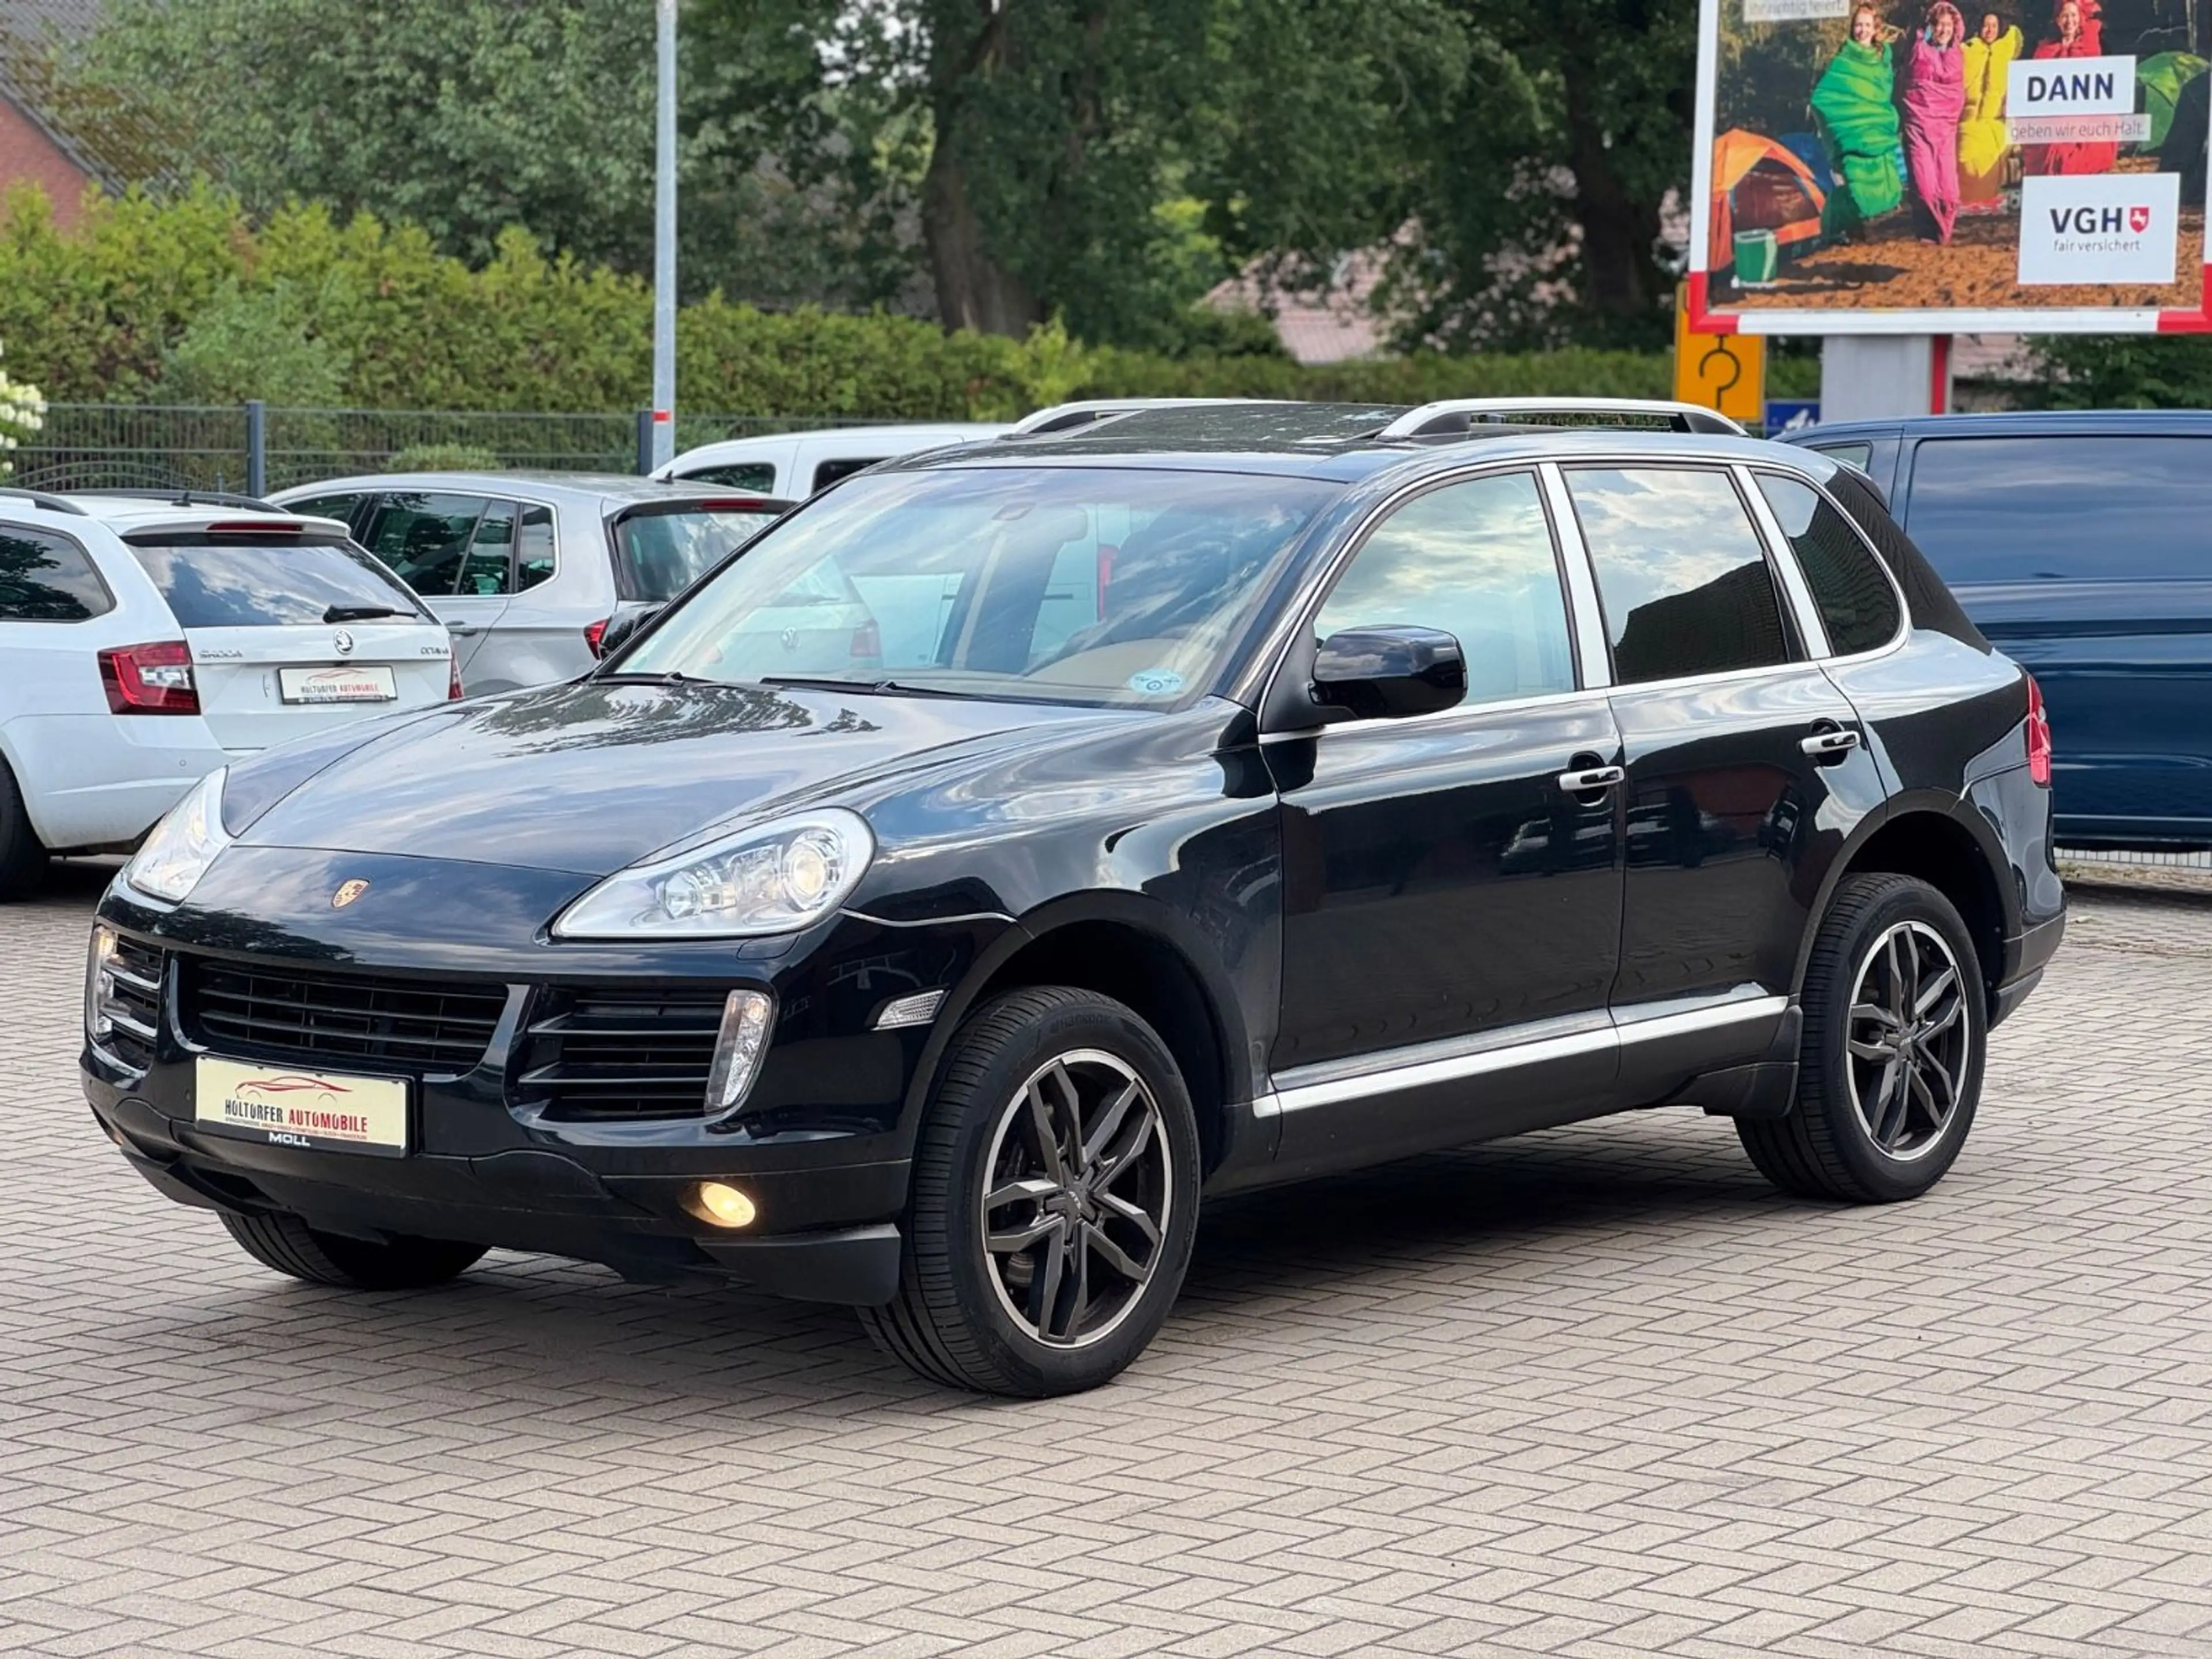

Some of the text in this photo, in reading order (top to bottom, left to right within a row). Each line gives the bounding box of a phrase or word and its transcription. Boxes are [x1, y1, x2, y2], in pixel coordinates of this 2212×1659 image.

[2027, 73, 2113, 102] DANN
[2011, 120, 2145, 141] geben wir euch Halt.
[2050, 207, 2123, 234] VGH
[2054, 238, 2141, 252] fair versichert
[225, 1099, 283, 1123] HOLTORFER
[289, 1108, 368, 1132] AUTOMOBILE
[268, 1131, 310, 1146] MOLL
